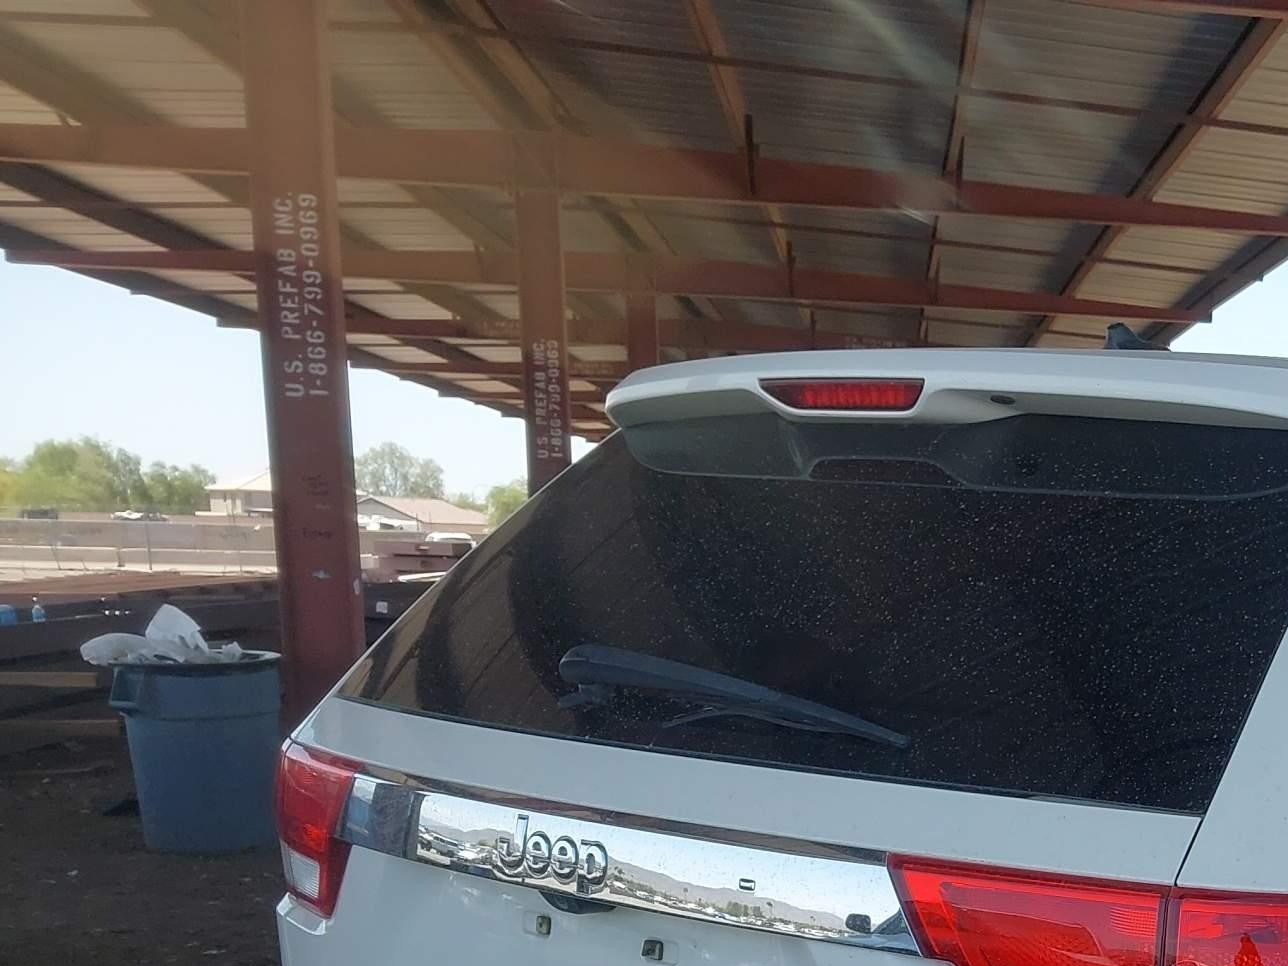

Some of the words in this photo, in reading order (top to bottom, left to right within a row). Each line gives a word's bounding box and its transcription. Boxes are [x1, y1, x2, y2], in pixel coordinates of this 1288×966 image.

[273, 192, 295, 235] INC.
[277, 248, 302, 340] PREFAB
[298, 193, 329, 396] 1-866-799-0969
[284, 353, 304, 397] U.S.
[496, 813, 608, 895] Jeep
